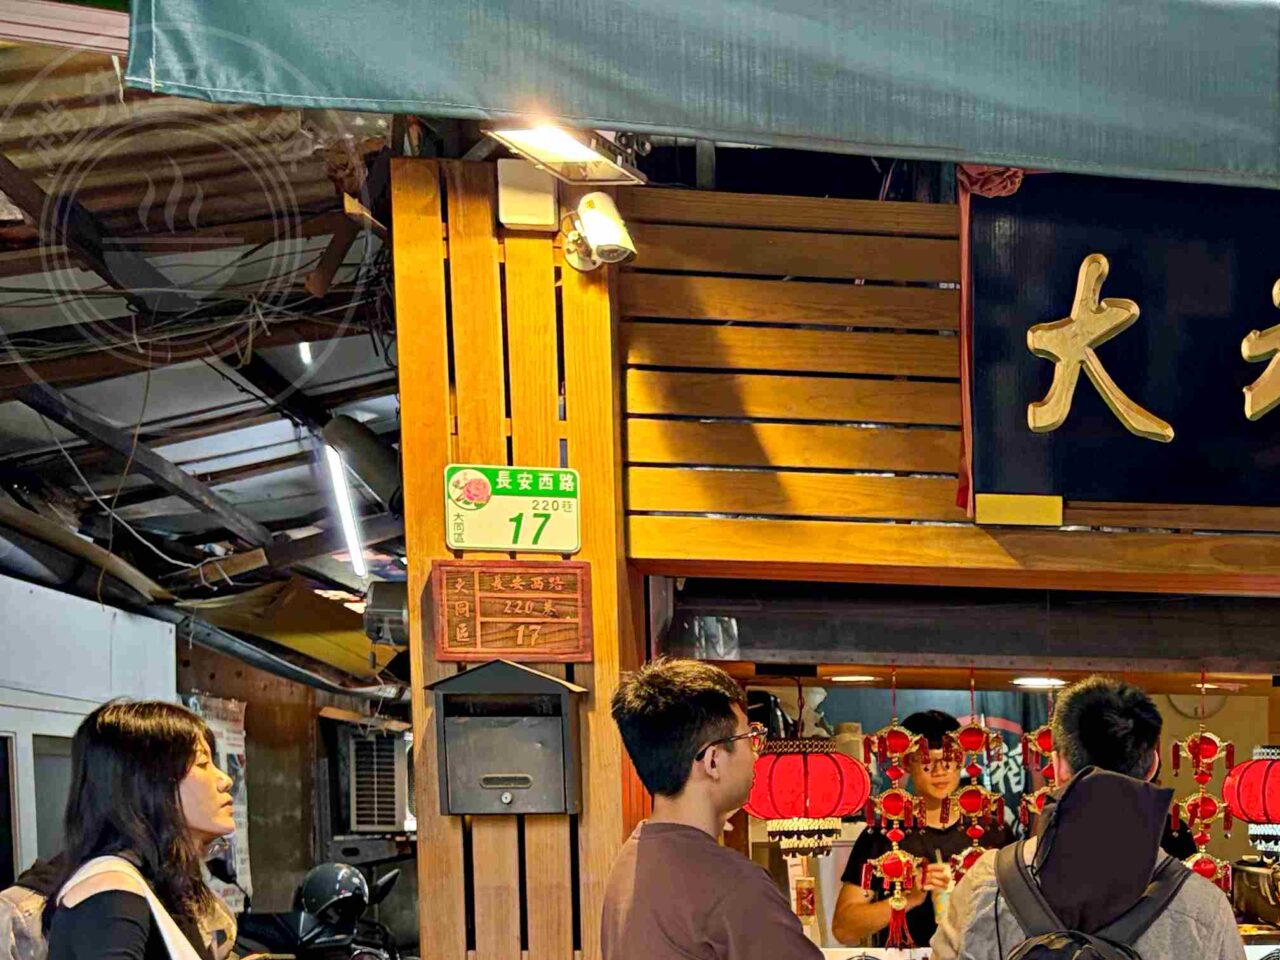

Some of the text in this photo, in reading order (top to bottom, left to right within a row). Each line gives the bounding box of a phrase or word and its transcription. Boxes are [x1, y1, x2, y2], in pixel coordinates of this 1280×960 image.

[496, 471, 575, 492] 長安西路
[532, 500, 573, 512] 220巷
[453, 512, 465, 544] 大同區
[508, 512, 551, 545] 17
[491, 574, 566, 591] 長安西路
[454, 577, 470, 642] 大同區
[516, 624, 542, 646] 17
